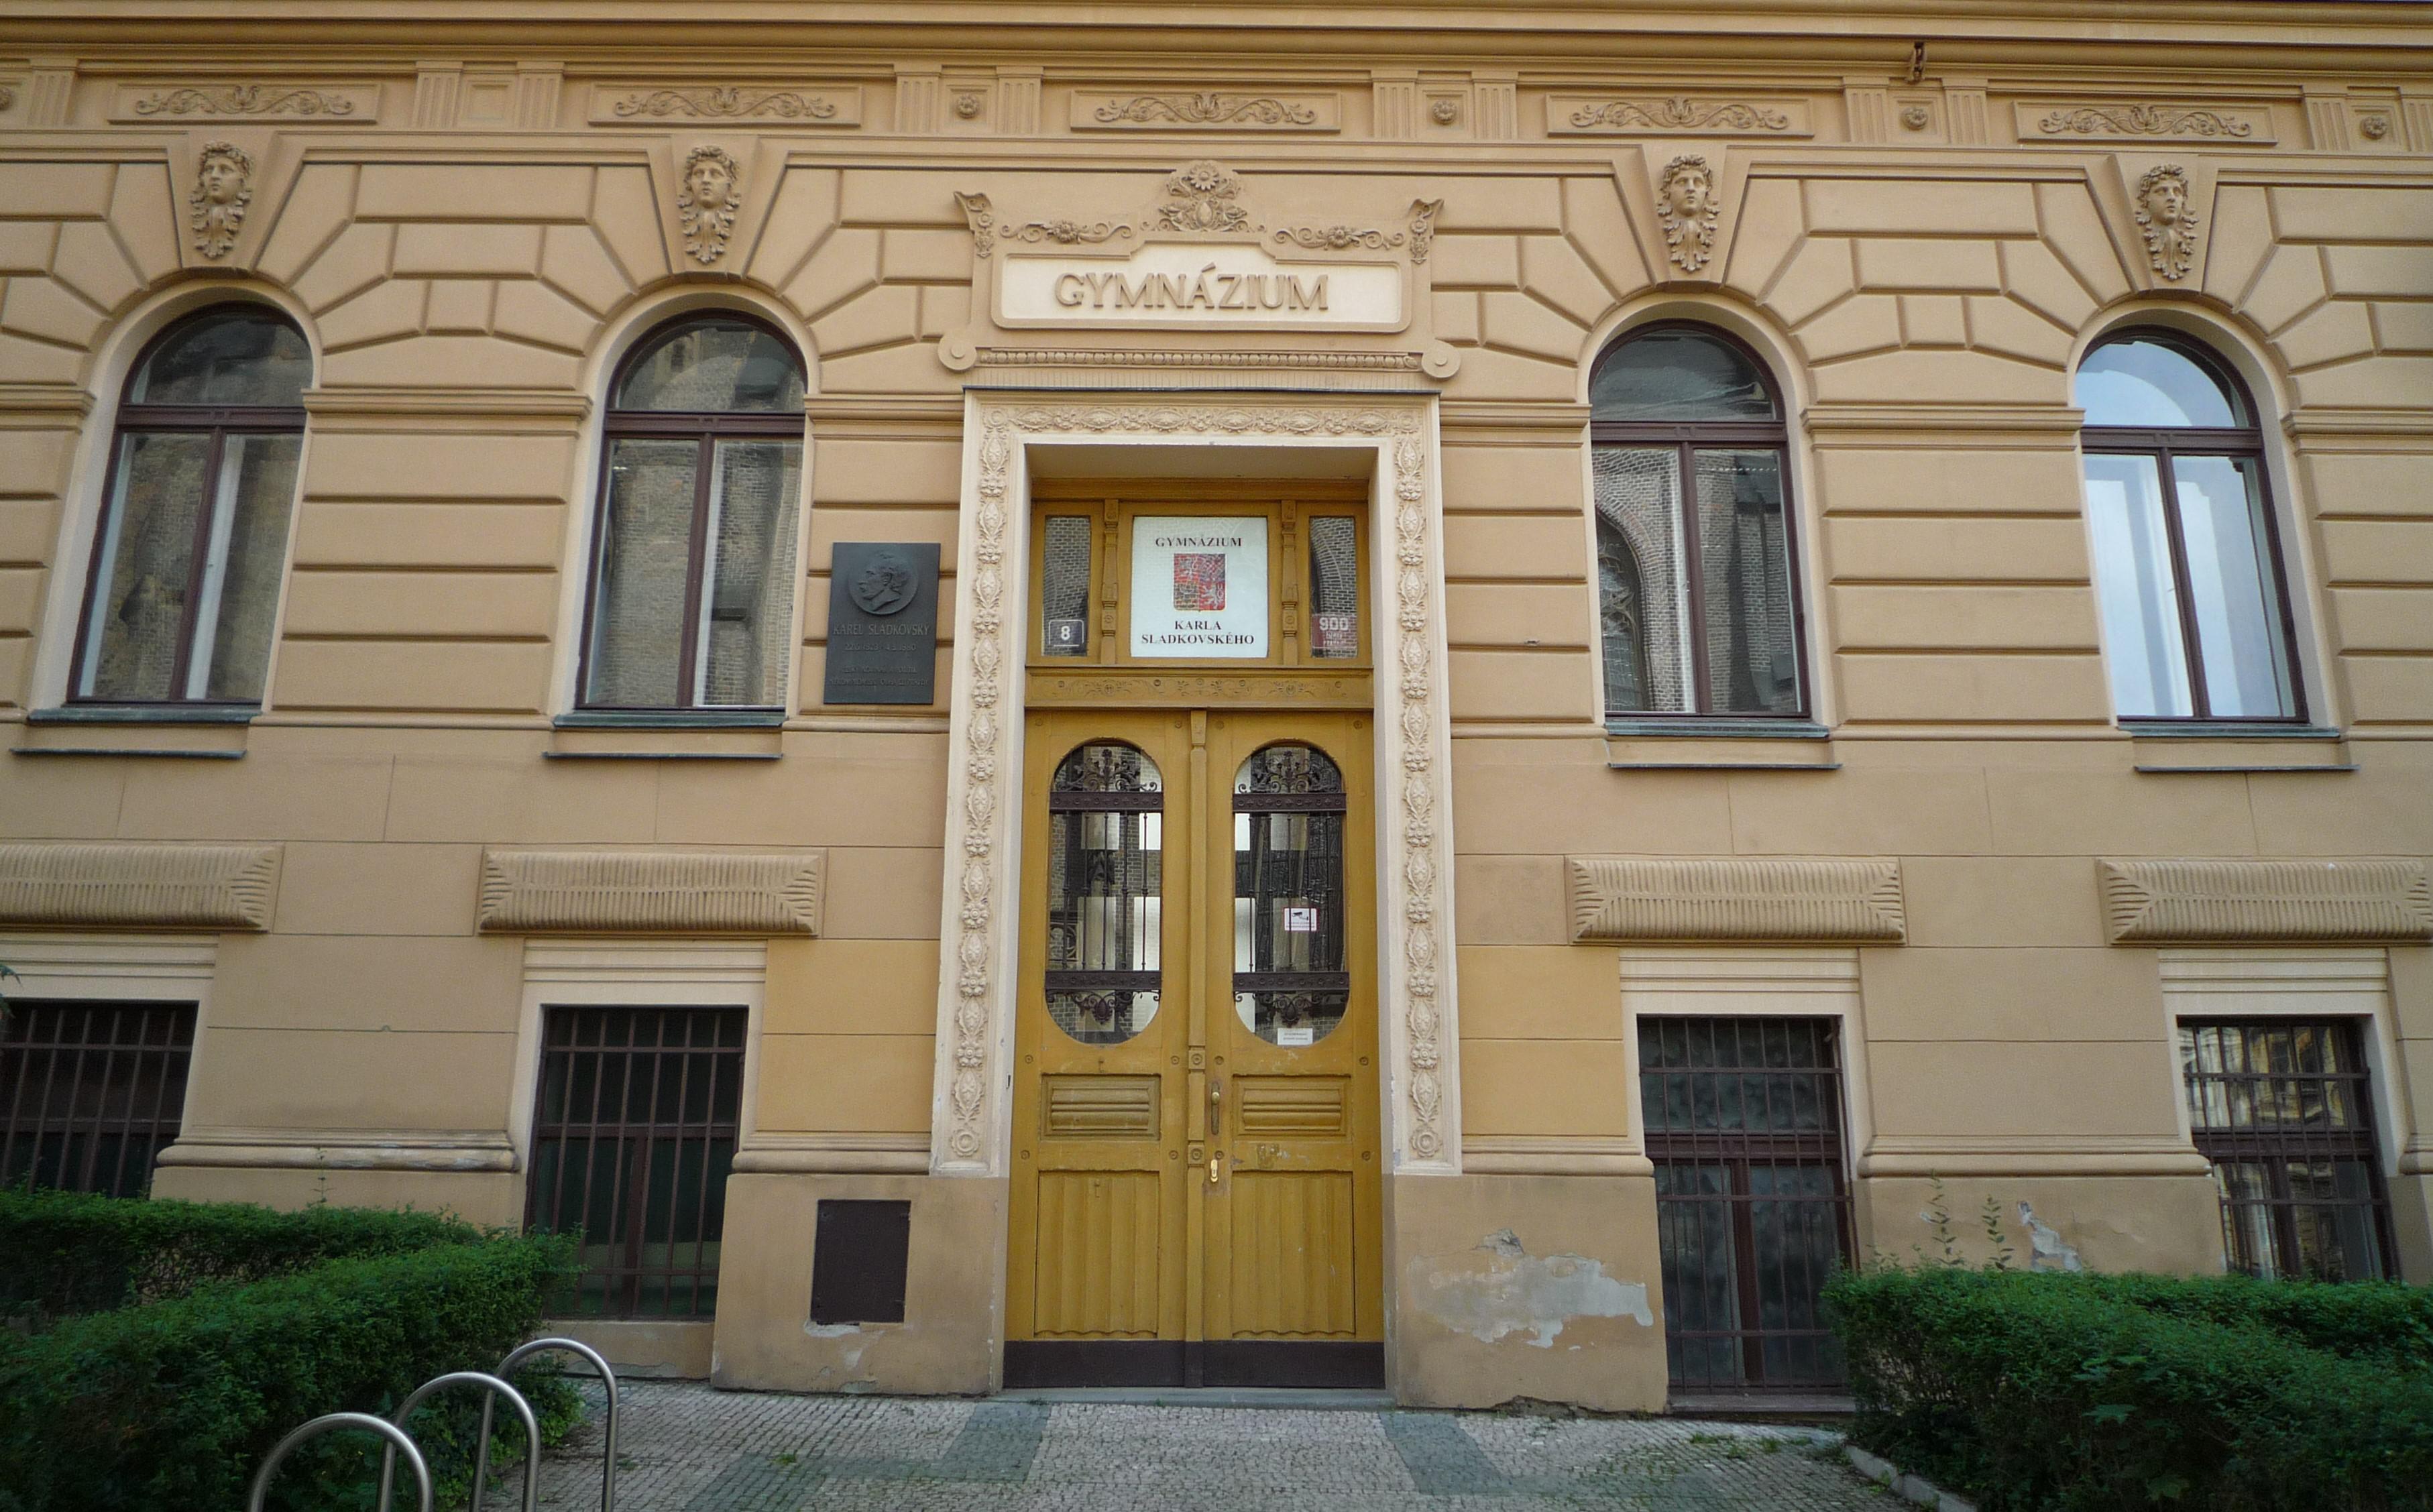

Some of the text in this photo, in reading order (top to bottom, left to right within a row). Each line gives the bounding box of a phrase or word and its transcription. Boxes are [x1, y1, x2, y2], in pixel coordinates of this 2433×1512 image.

[1054, 262, 1328, 310] GYMNÁZIUM
[1155, 534, 1242, 547] GYMNÁZIUM
[1174, 620, 1222, 630] KARLA
[1319, 617, 1349, 630] 900
[1061, 626, 1070, 640] 8
[1141, 632, 1255, 644] SLADKOVSKÉHO
